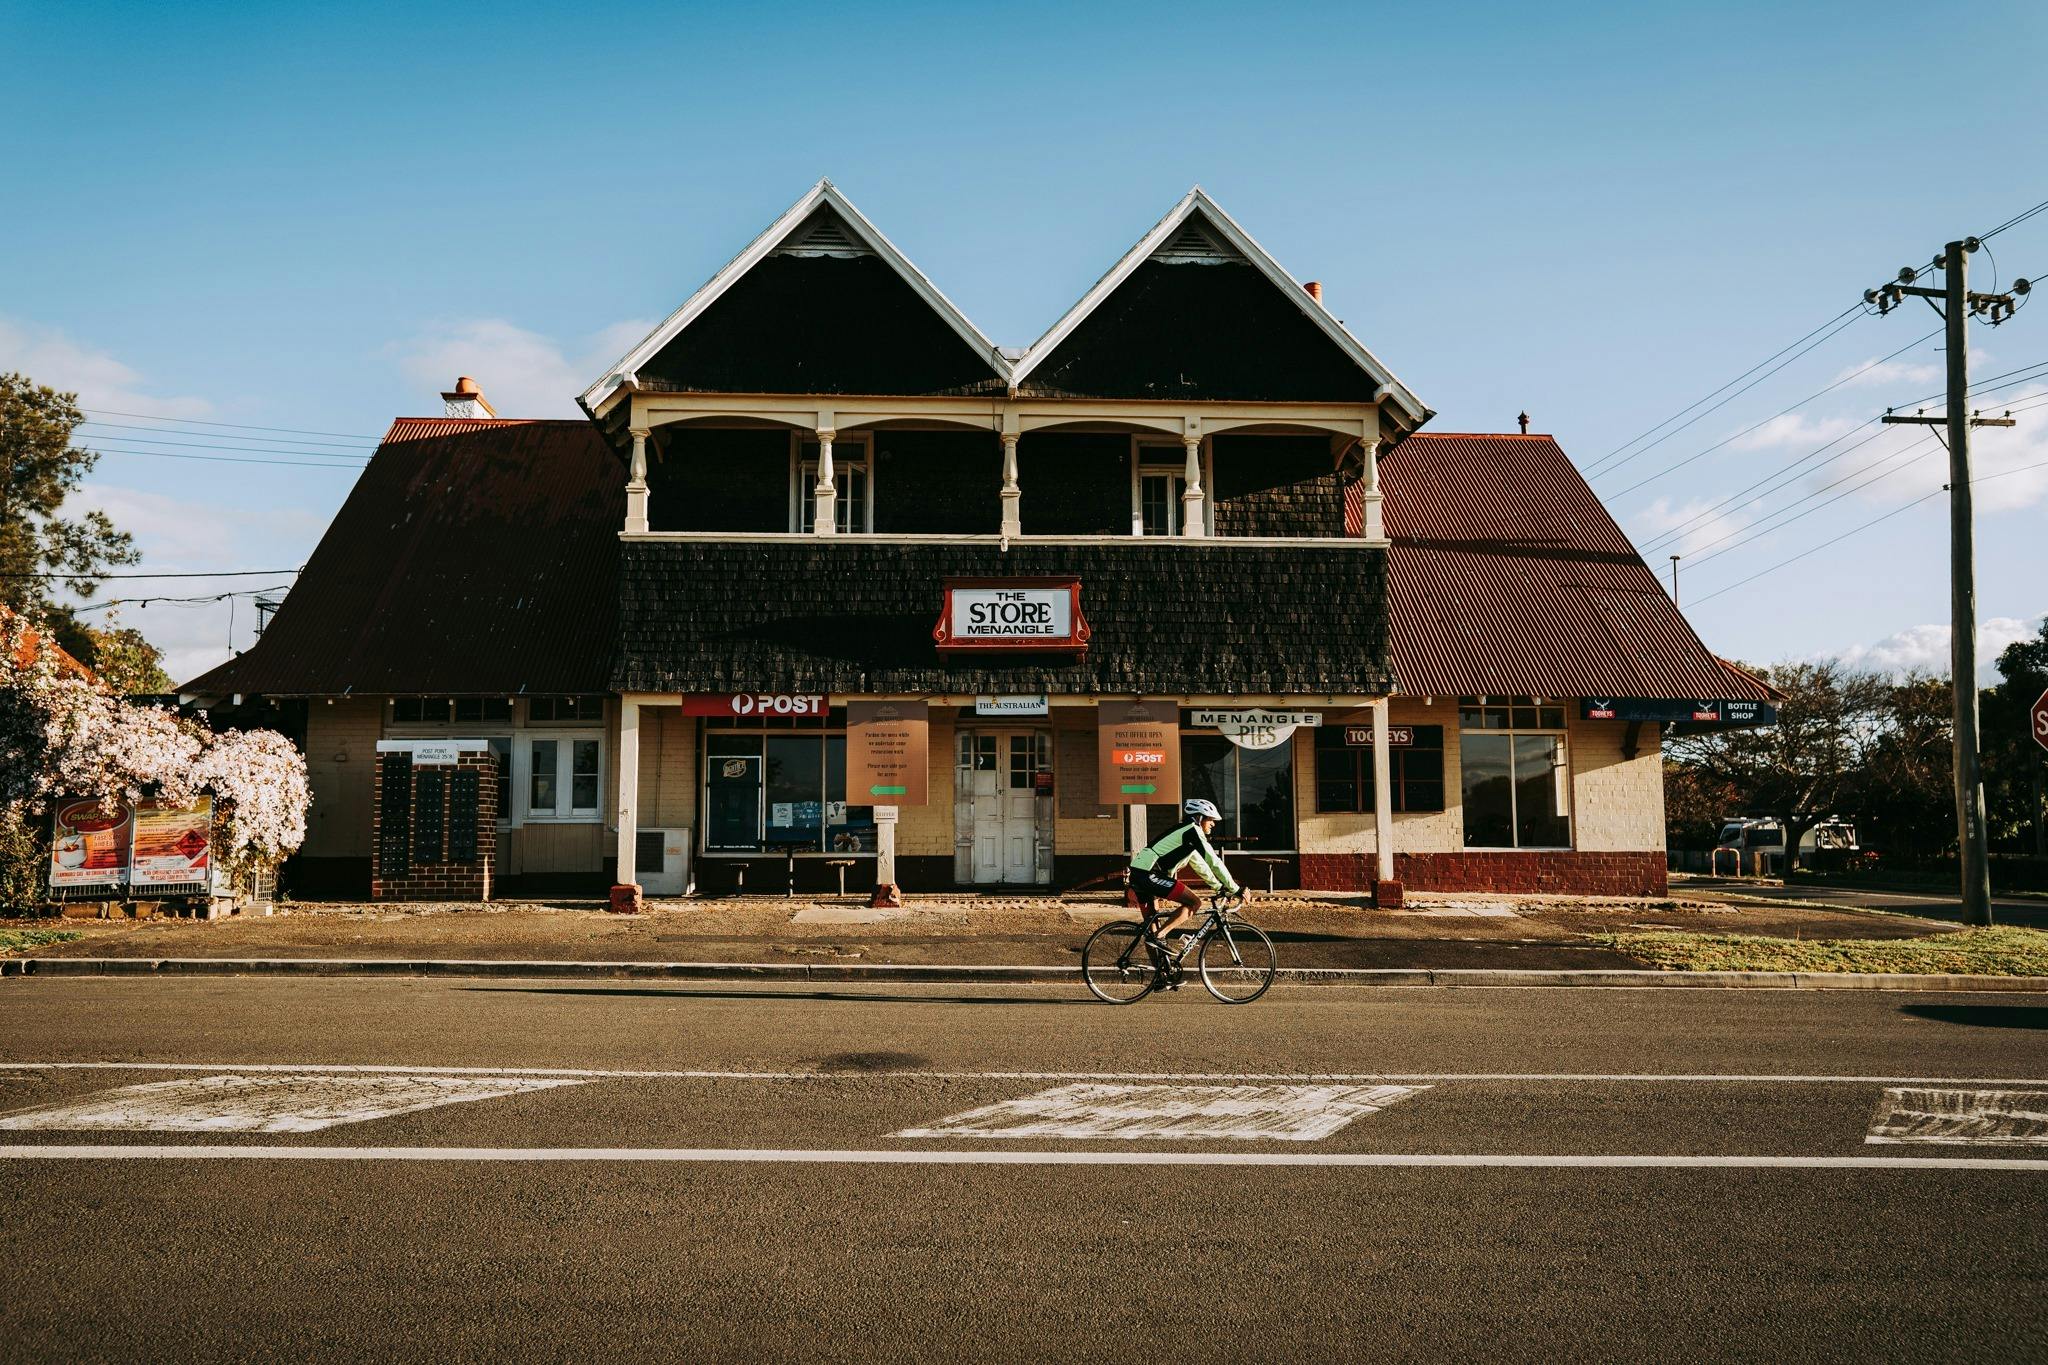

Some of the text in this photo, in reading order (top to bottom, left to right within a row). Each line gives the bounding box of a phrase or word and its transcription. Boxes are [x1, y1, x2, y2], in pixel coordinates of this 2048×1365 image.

[996, 592, 1025, 601] THE
[970, 603, 1051, 623] STORE
[967, 625, 1054, 634] MENANGLE
[759, 695, 823, 713] POST
[1200, 714, 1314, 723] MENANGLE
[1239, 725, 1276, 746] PIES
[1349, 731, 1408, 742] TOOEYS
